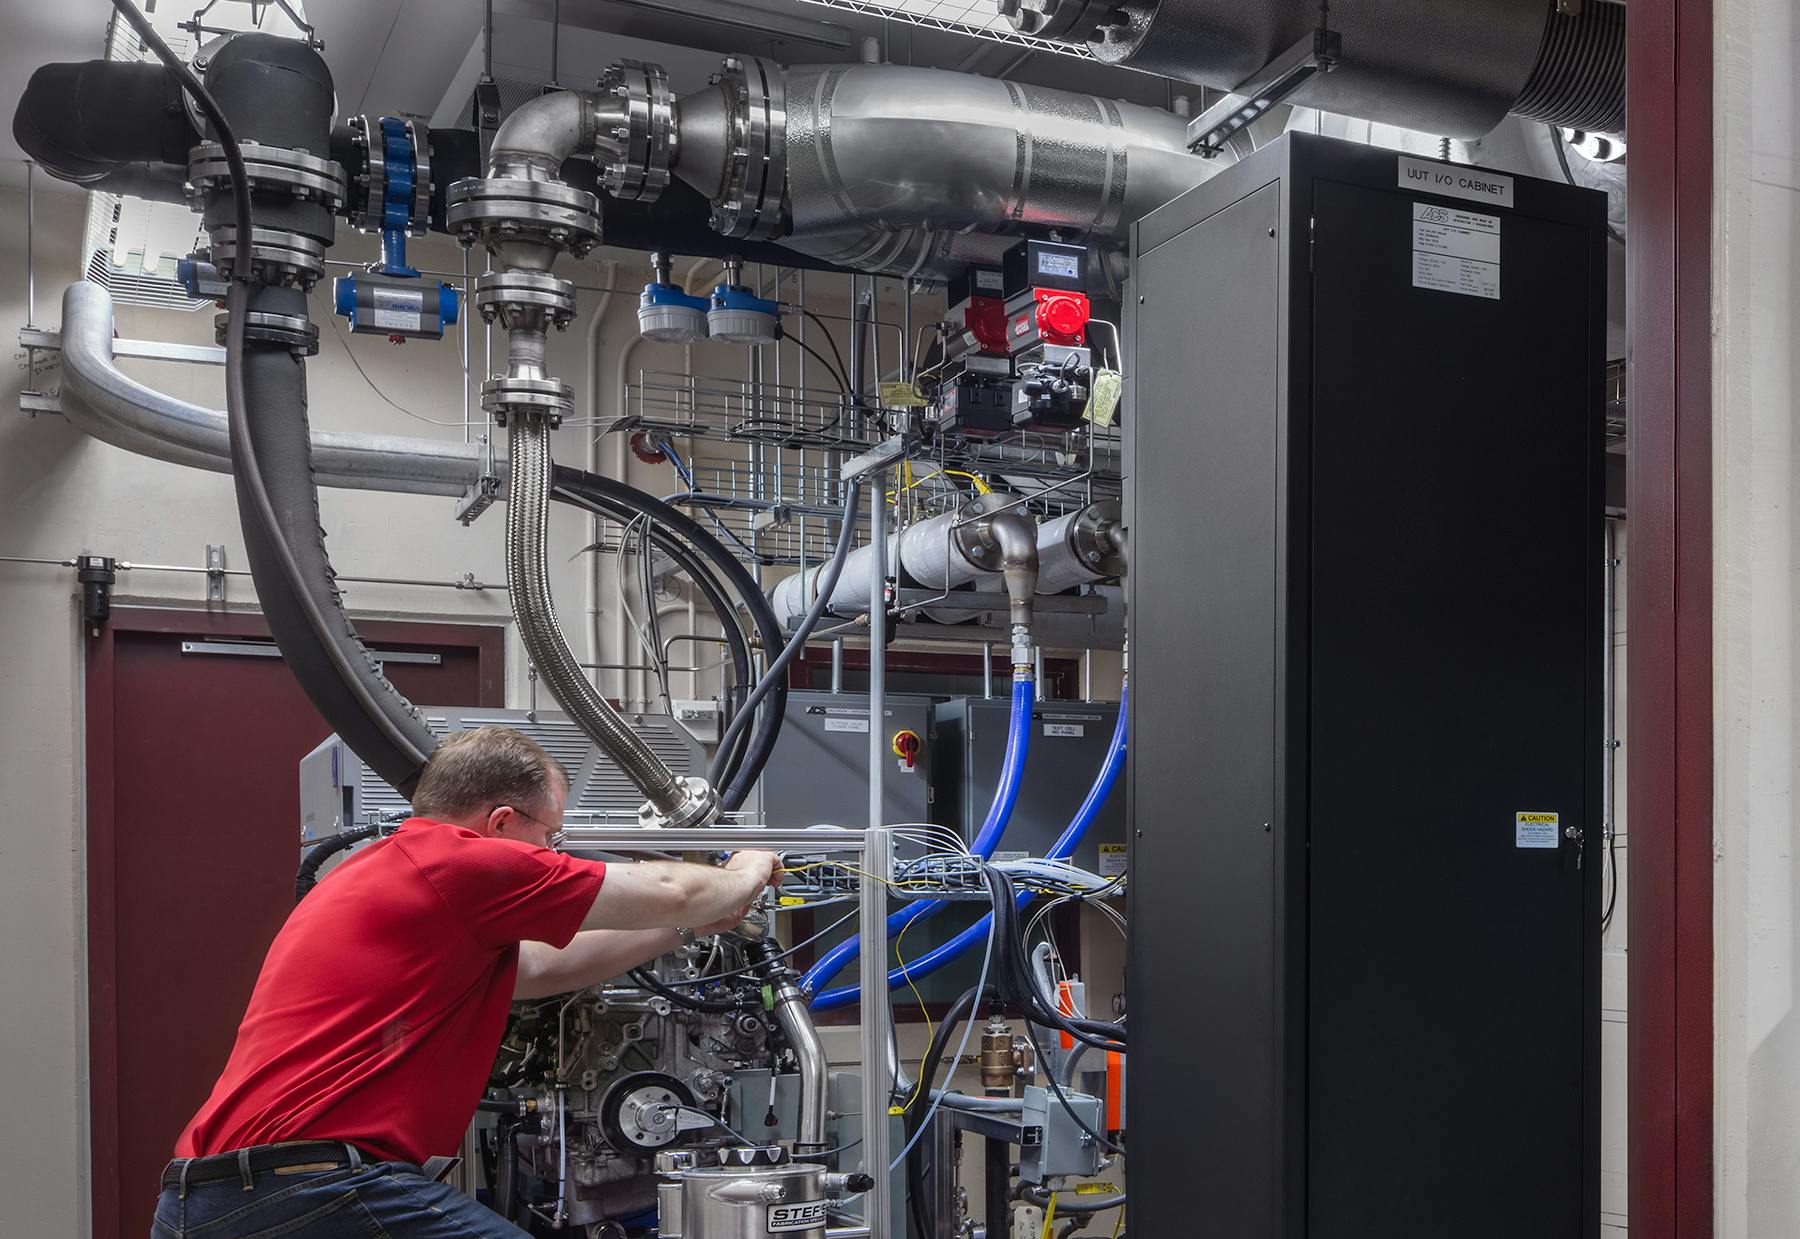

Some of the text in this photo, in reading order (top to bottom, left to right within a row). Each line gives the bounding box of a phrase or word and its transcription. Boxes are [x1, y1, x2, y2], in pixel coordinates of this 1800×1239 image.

[1407, 168, 1505, 195] UUT I/O CABINET
[1420, 206, 1449, 223] ACS
[806, 706, 826, 715] ACS
[772, 1218, 810, 1227] FABRICATION
